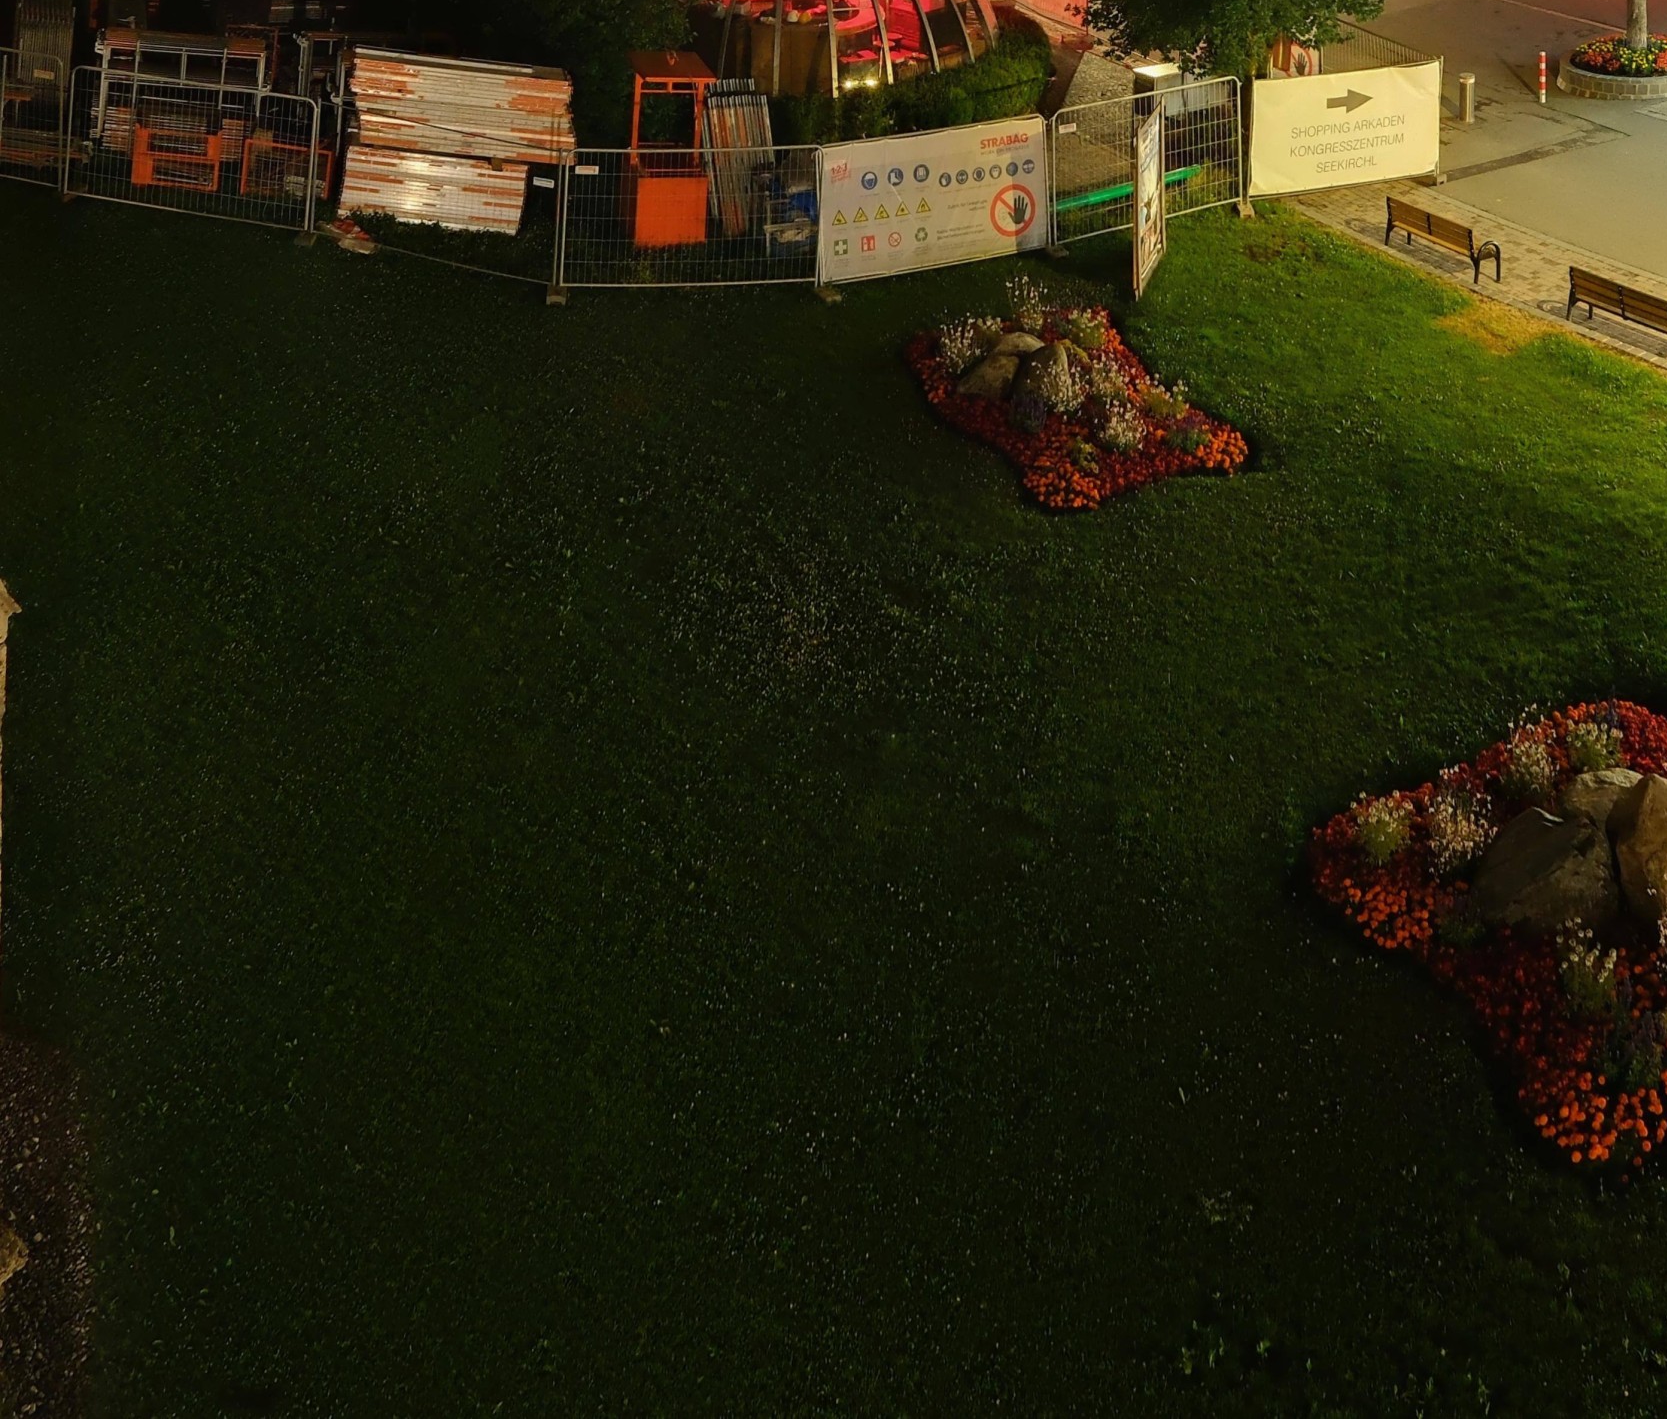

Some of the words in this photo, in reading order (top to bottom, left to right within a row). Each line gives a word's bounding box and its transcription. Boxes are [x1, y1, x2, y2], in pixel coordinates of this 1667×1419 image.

[1291, 121, 1351, 140] SHOPPING
[1353, 114, 1405, 133] ARKADEN
[980, 132, 1029, 151] STRABAG
[1290, 133, 1404, 158] KONGRESSZENTRUM
[1316, 155, 1377, 174] SEEKIRCHL
